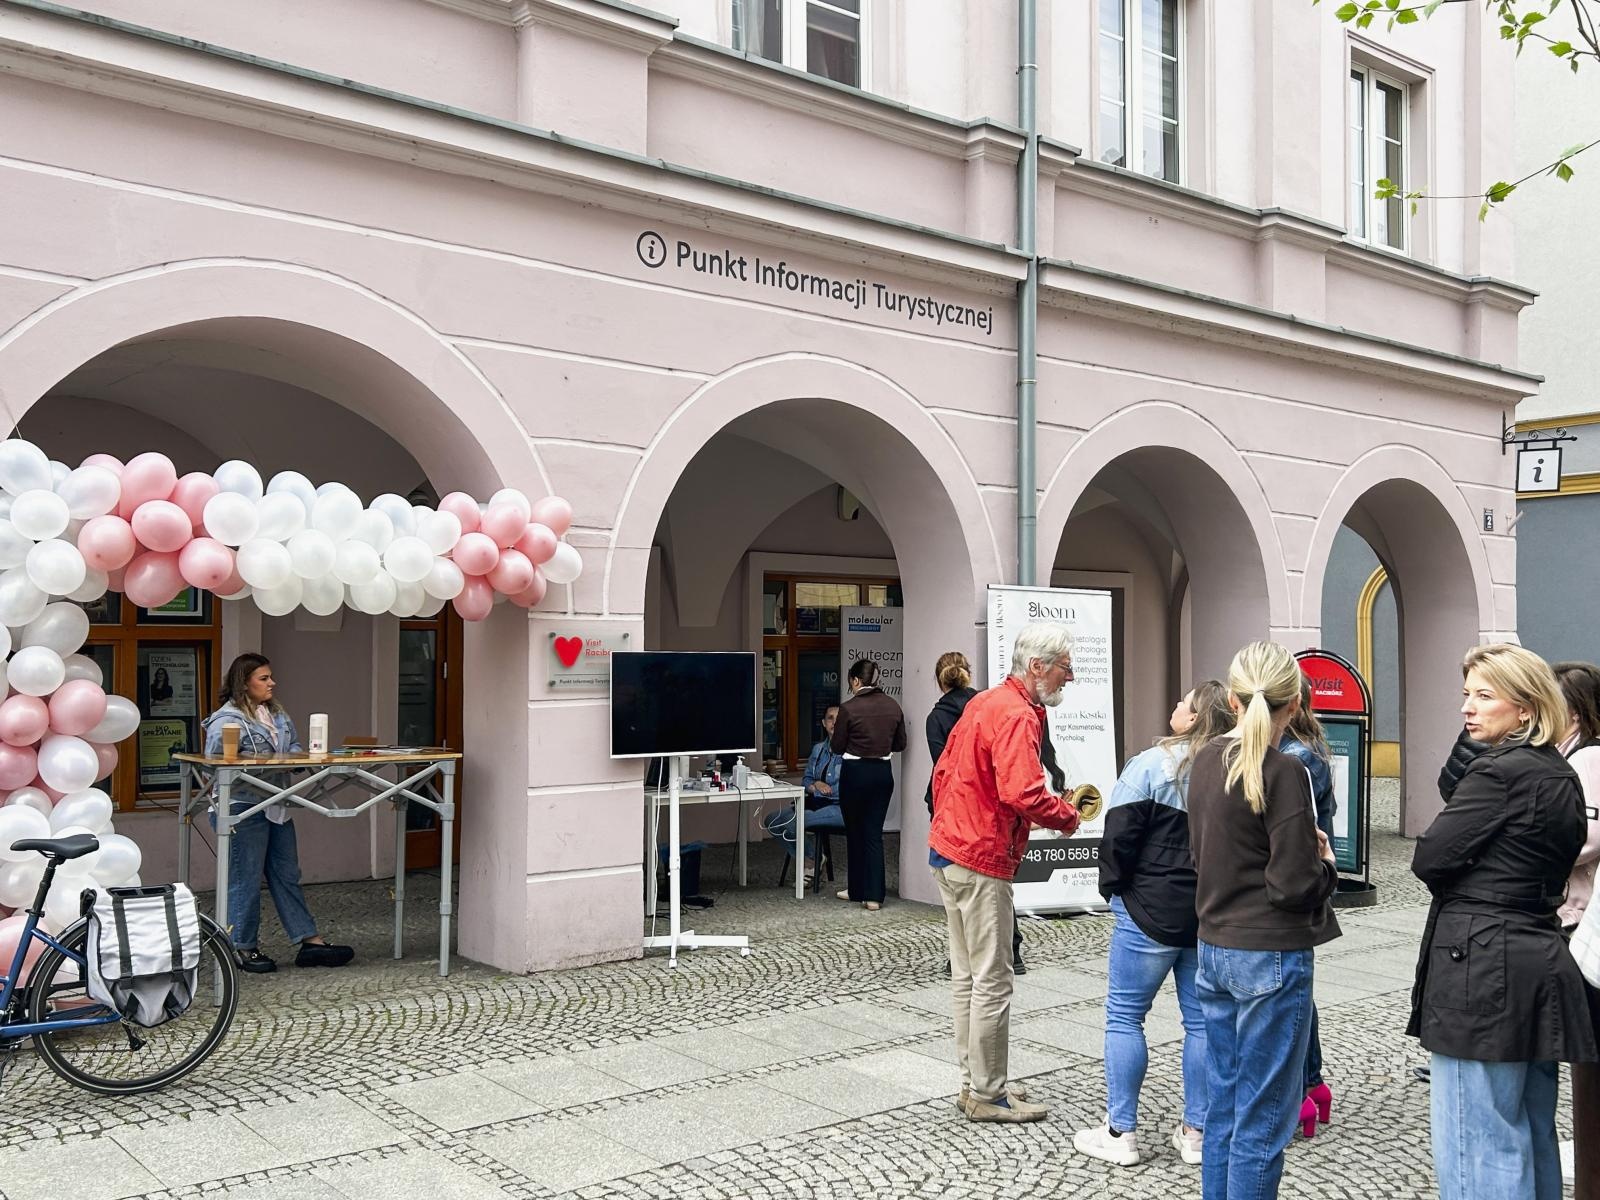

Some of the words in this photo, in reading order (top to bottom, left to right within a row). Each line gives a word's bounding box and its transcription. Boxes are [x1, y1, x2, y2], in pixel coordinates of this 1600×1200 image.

[676, 240, 748, 282] Punkt
[755, 257, 867, 309] Informacji
[873, 282, 993, 335] Turystycznej
[1486, 515, 1492, 526] 2
[1028, 601, 1076, 619] Bloom
[848, 614, 894, 625] molecular
[585, 639, 602, 647] Visit
[848, 648, 903, 661] Skuteczn
[1075, 646, 1107, 655] chologia
[1073, 666, 1107, 675] stetyczna
[1314, 677, 1344, 690] Visit
[1080, 710, 1107, 719] Kostka
[1056, 734, 1085, 743] Trycholog
[1043, 848, 1066, 861] 780
[1068, 847, 1090, 860] 559
[1091, 847, 1099, 860] 5
